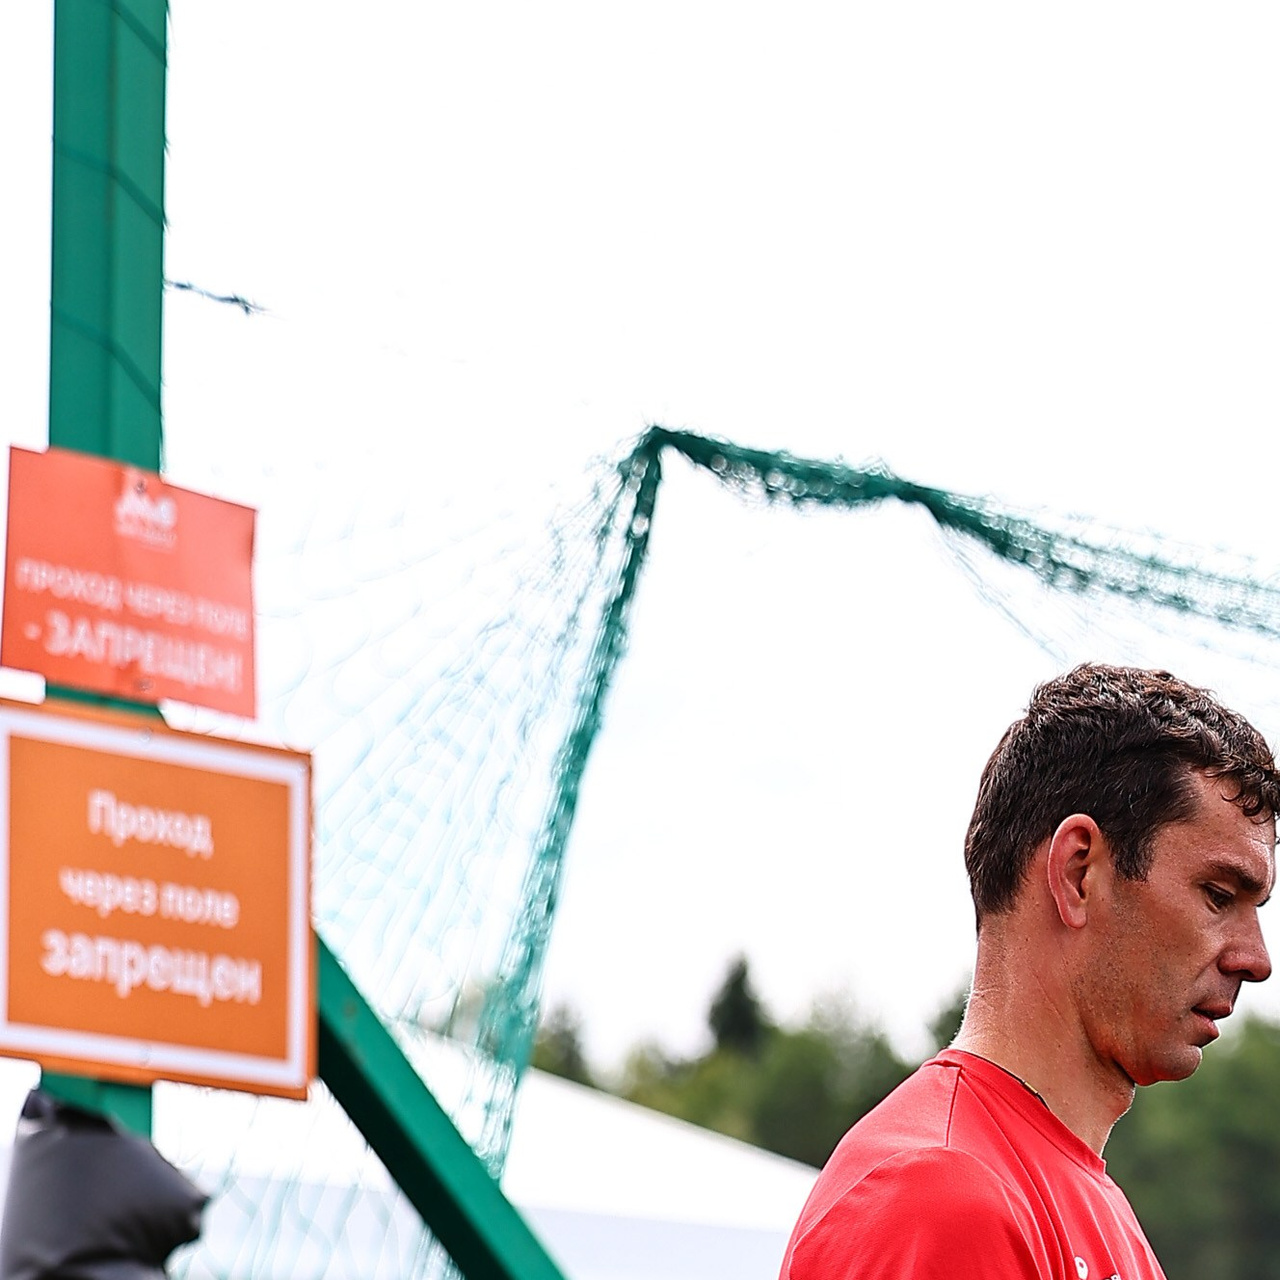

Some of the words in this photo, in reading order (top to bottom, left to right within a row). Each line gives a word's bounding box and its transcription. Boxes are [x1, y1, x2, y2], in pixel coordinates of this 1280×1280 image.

[87, 786, 215, 861] Проход
[57, 865, 159, 918] через
[158, 881, 241, 930] поле
[40, 928, 262, 1009] запрещен
